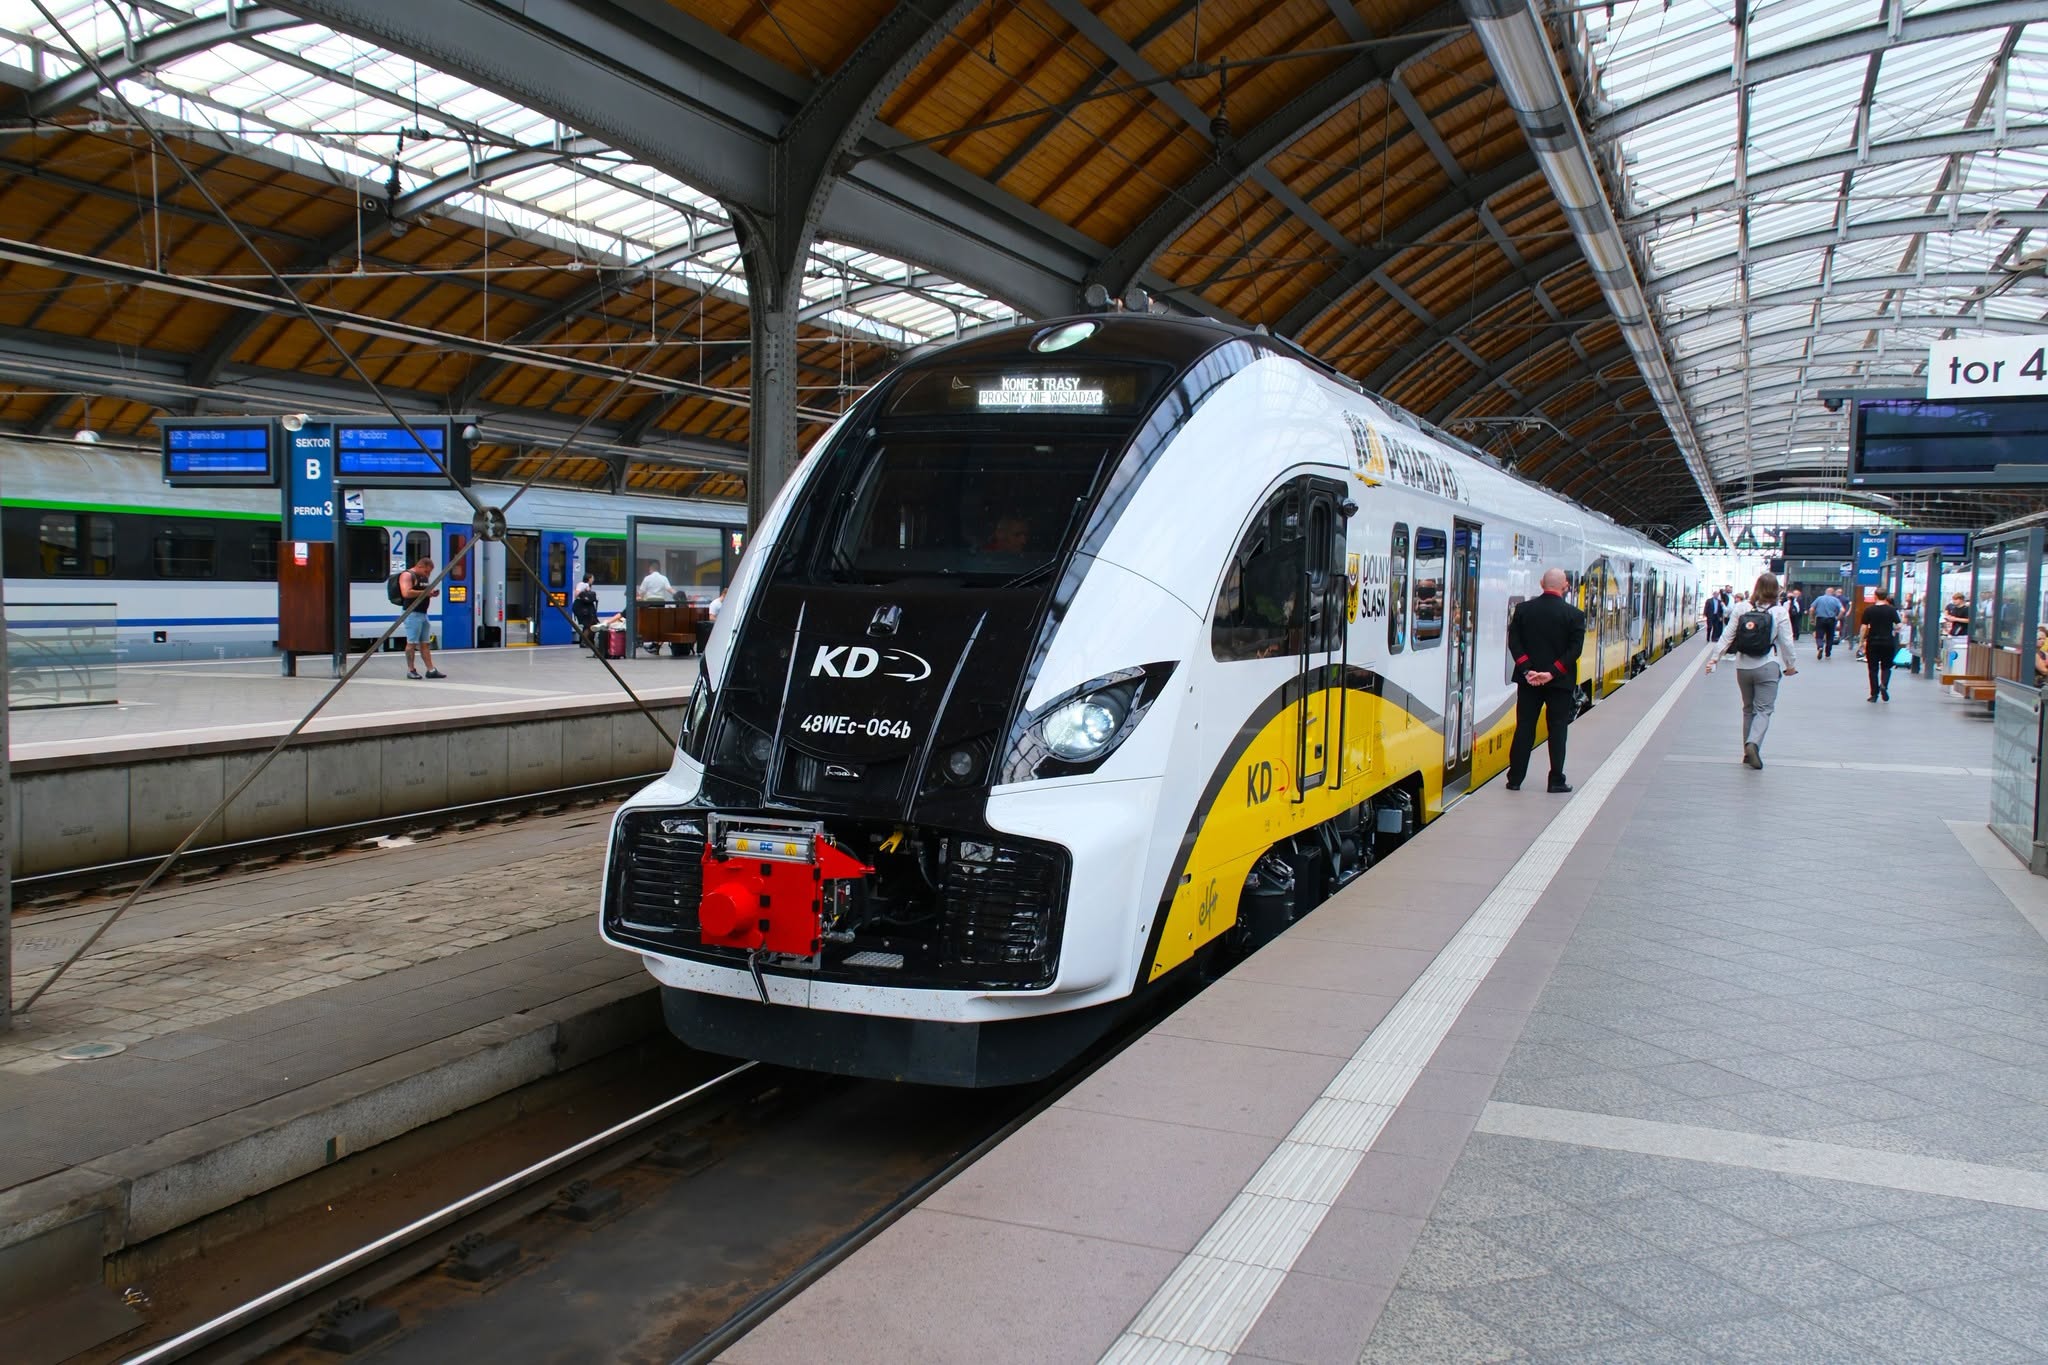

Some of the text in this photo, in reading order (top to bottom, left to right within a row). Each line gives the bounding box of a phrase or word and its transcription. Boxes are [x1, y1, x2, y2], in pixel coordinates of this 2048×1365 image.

[1949, 347, 2048, 385] tor 4
[1002, 377, 1081, 391] KONIEC TRASY
[980, 391, 1027, 404] PROSIMY
[1030, 391, 1047, 404] NIE
[295, 438, 331, 448] SEKTOR
[306, 458, 321, 480] B
[1381, 434, 1441, 495] POJAZD
[1436, 457, 1459, 502] KD
[293, 506, 323, 516] PERON
[323, 501, 334, 517] 3
[392, 530, 404, 556] 2
[1868, 547, 1879, 558] B
[1362, 554, 1390, 585] DOLNY
[1361, 582, 1387, 623] ŚLĄSK
[810, 645, 880, 679] KD
[800, 714, 912, 740] 48WEc-064b
[1448, 703, 1457, 758] 2
[1246, 760, 1273, 809] KD
